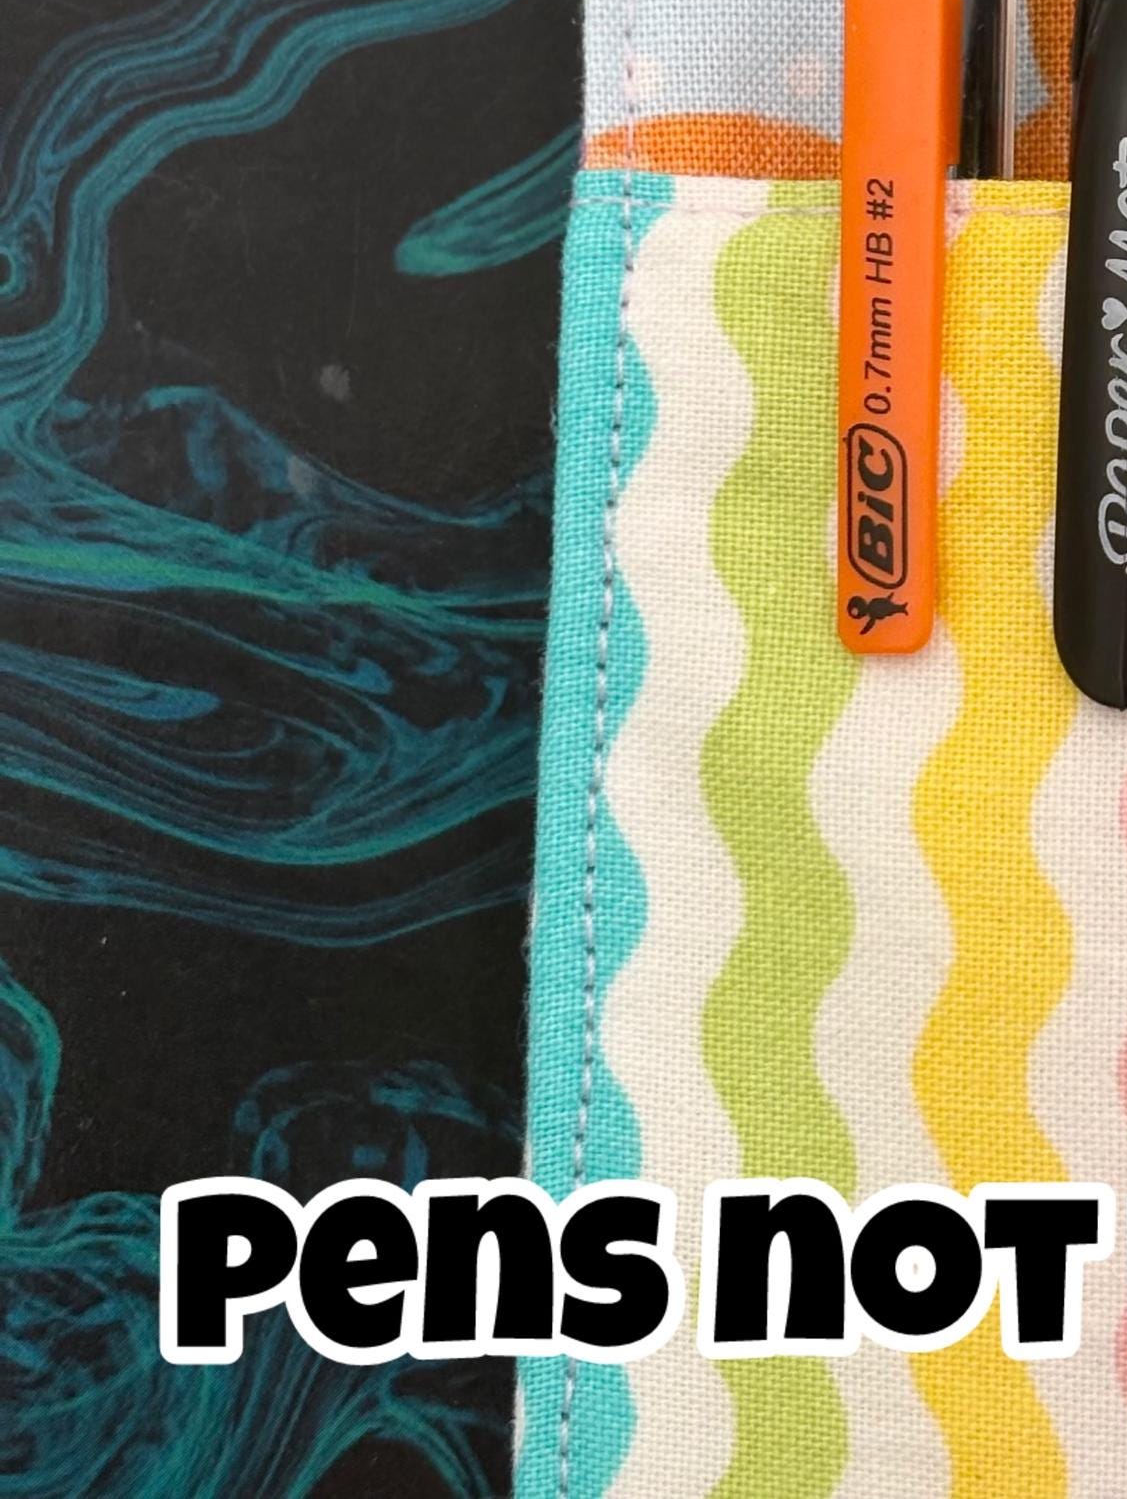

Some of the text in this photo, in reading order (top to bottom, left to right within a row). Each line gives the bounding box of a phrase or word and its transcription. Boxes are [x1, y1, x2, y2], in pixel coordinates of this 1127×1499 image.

[866, 178, 895, 219] #2
[866, 231, 894, 285] HB
[863, 297, 893, 415] 0.7mm
